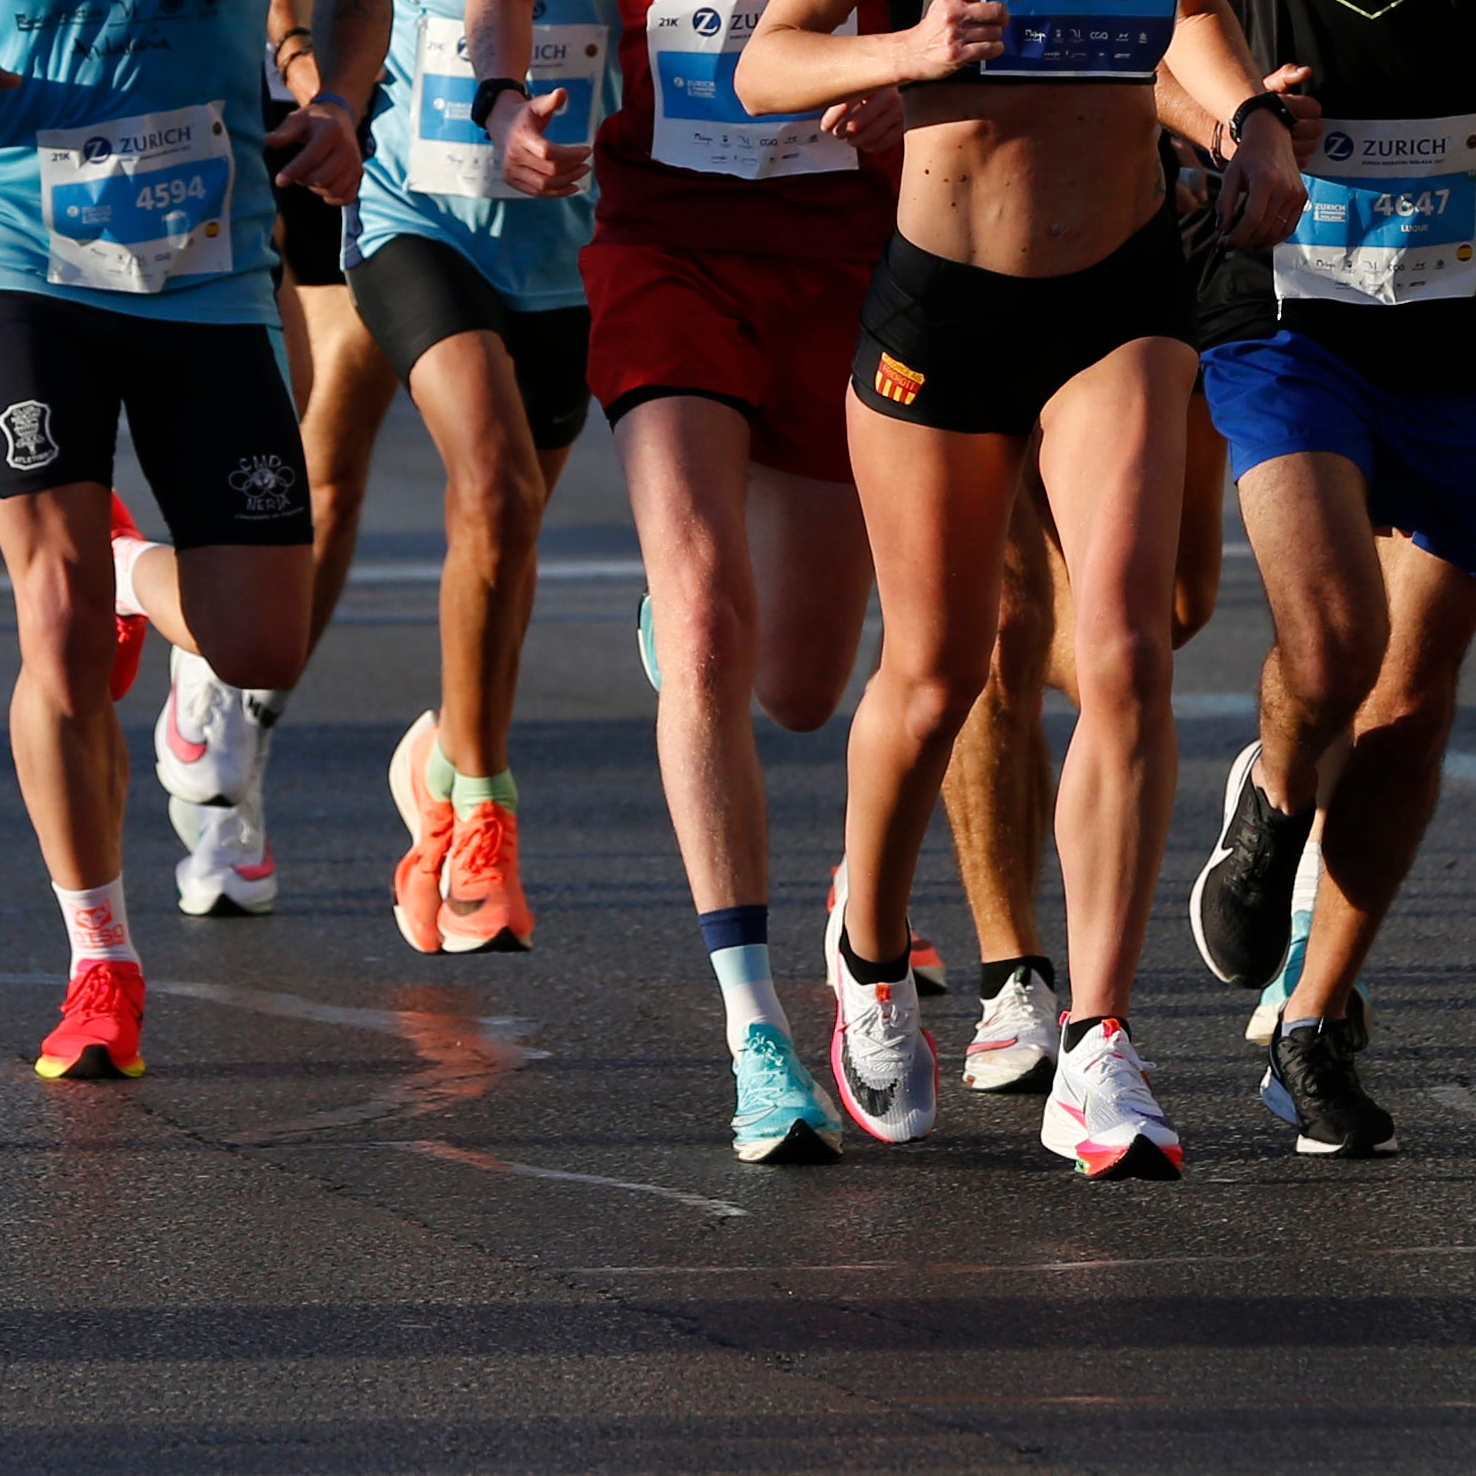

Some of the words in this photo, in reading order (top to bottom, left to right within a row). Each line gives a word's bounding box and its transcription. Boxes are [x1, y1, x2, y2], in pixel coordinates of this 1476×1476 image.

[658, 17, 679, 27] 21K
[51, 151, 70, 162] 21K
[120, 126, 192, 153] ZURICH
[1362, 139, 1446, 156] ZURICH
[136, 175, 207, 210] 4594
[1374, 188, 1450, 217] 4647
